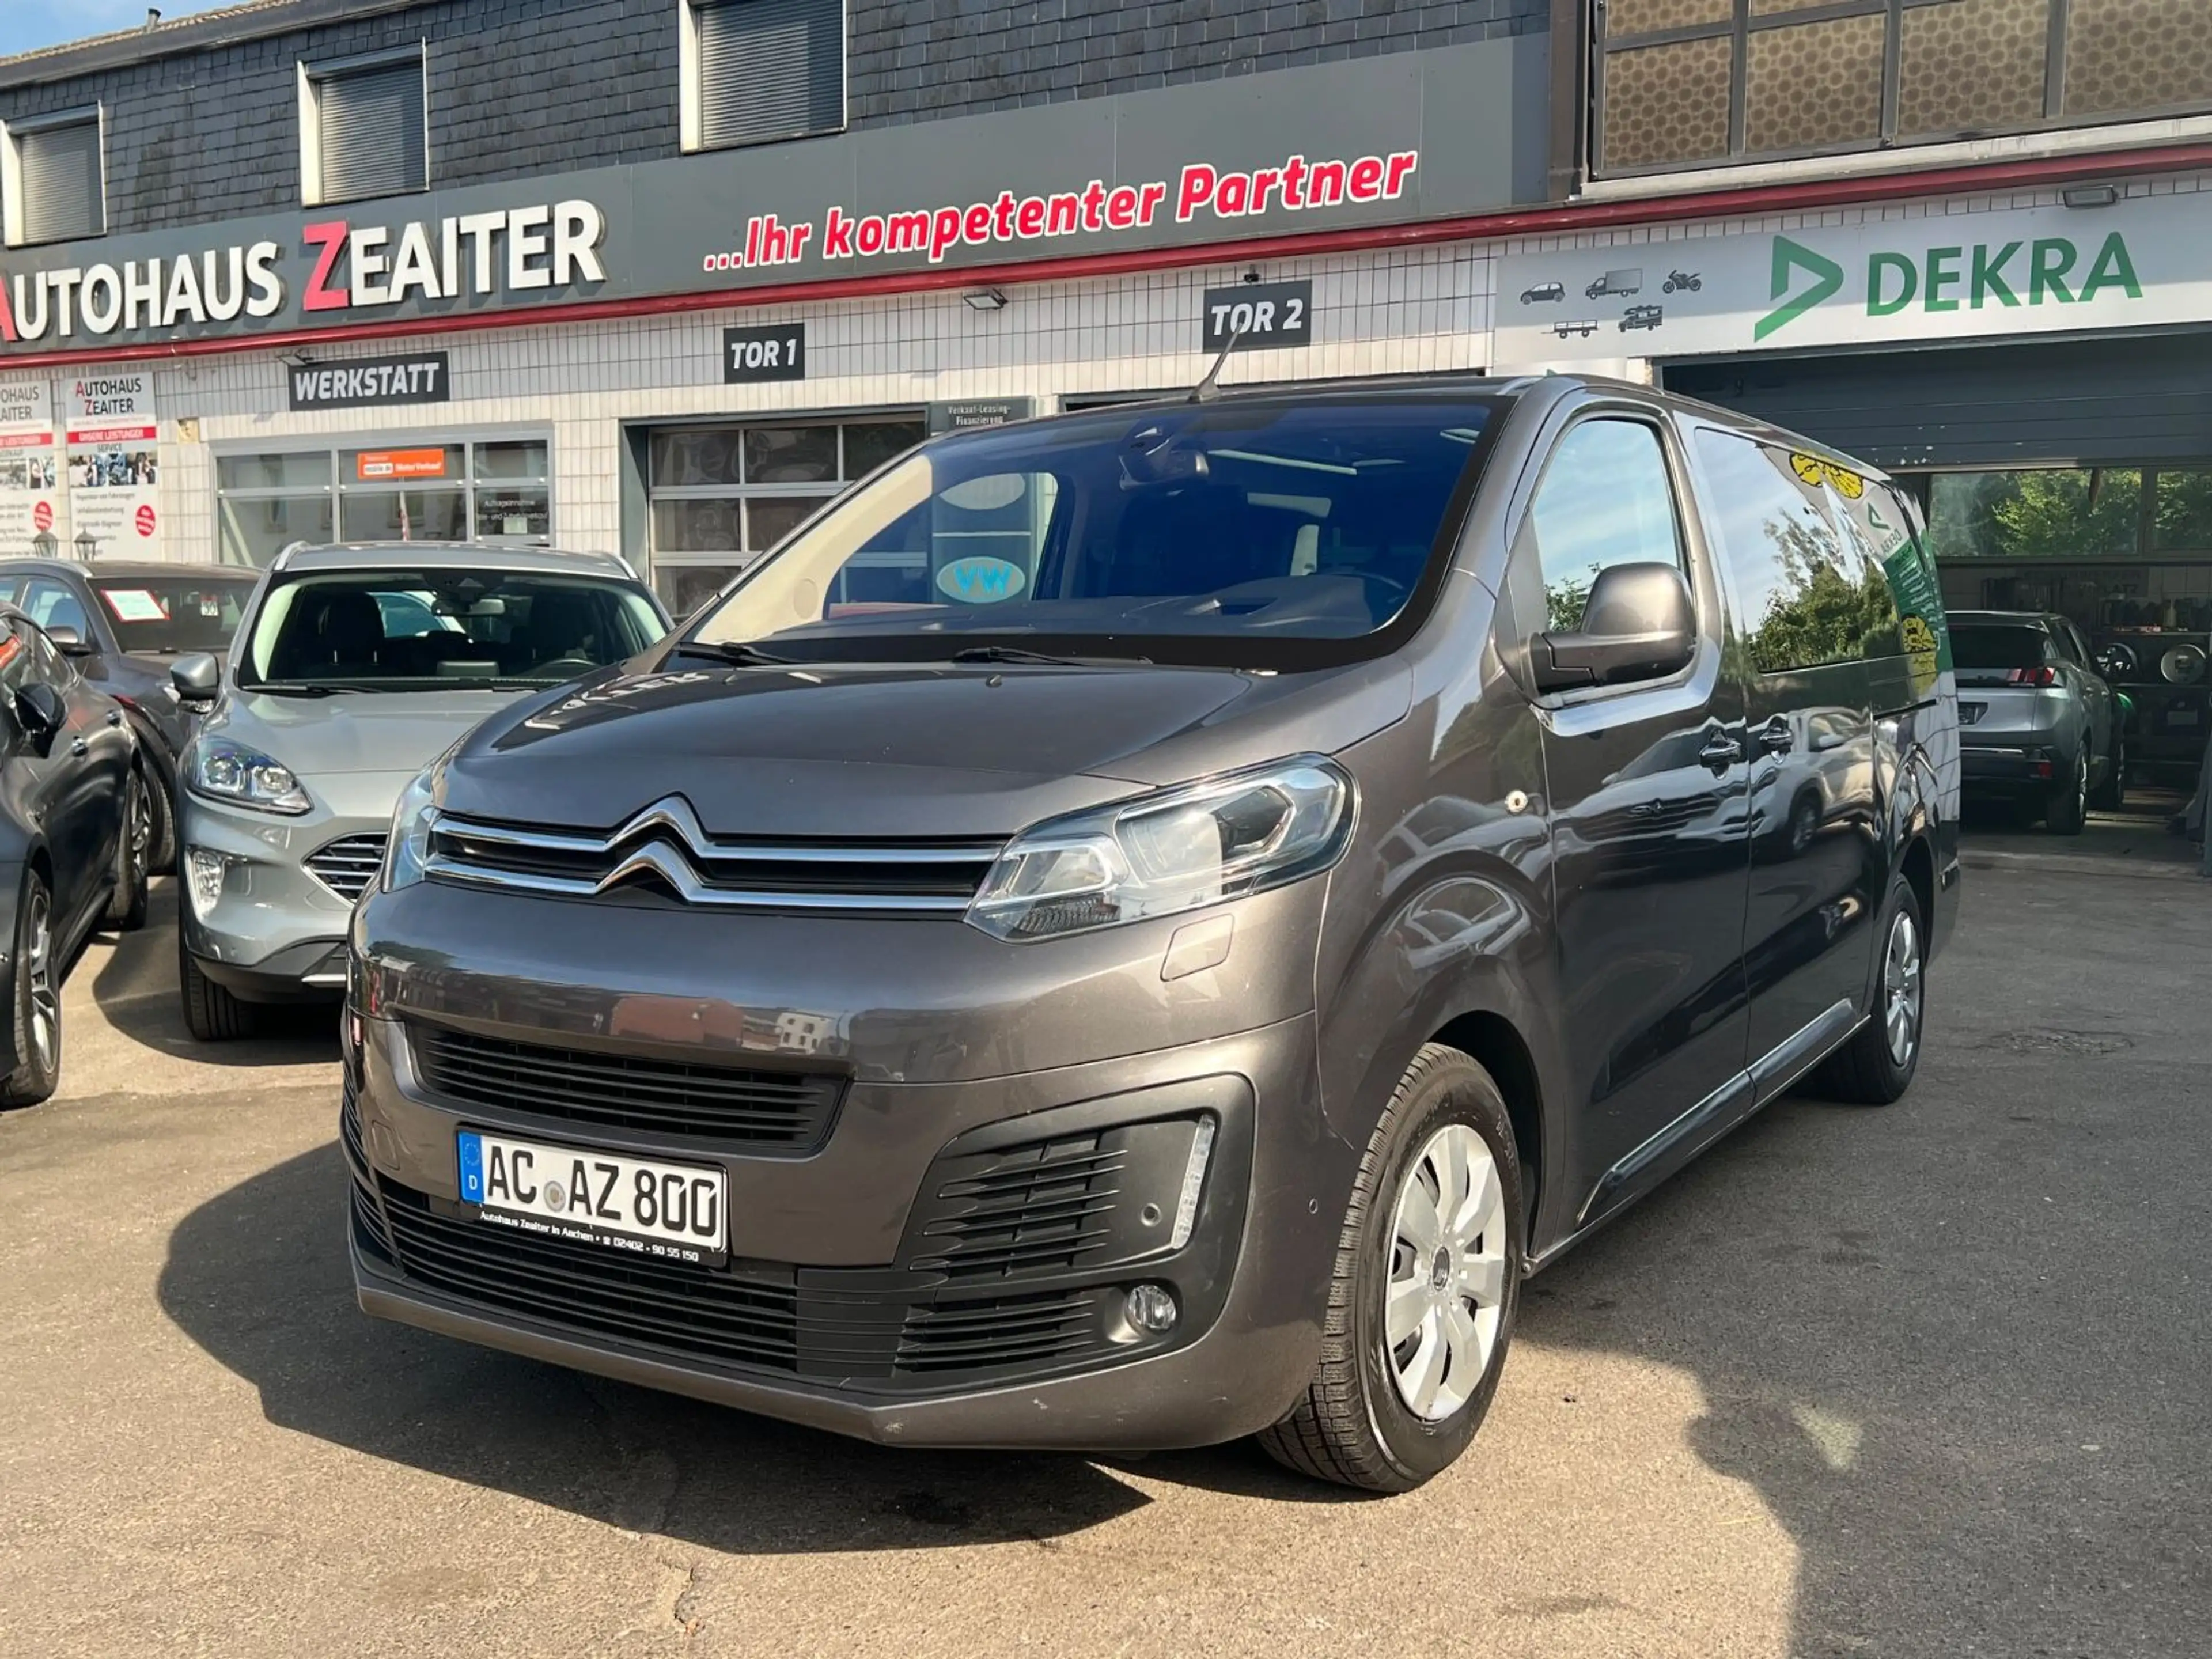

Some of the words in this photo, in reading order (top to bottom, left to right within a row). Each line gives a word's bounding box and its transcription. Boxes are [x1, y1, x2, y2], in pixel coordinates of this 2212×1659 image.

[822, 181, 1165, 262] kompetenter
[1176, 150, 1418, 223] Partner
[302, 199, 608, 312] ZEAITER
[1866, 231, 2144, 316] DEKRA
[1210, 301, 1277, 335] TOR
[1282, 298, 1304, 331] 2
[730, 340, 781, 370] TOR
[786, 338, 797, 367] 1
[0, 385, 40, 404] OHAUS
[76, 377, 142, 398] AUTOHAUS
[294, 361, 441, 402] WERKSTATT
[0, 406, 32, 422] AITER
[85, 398, 134, 416] ZEAITER
[955, 562, 1013, 594] VW
[468, 1175, 478, 1190] D
[488, 1145, 537, 1204] AC
[569, 1159, 622, 1221] AZ
[634, 1169, 717, 1237] 800
[480, 1211, 519, 1226] Autohaus
